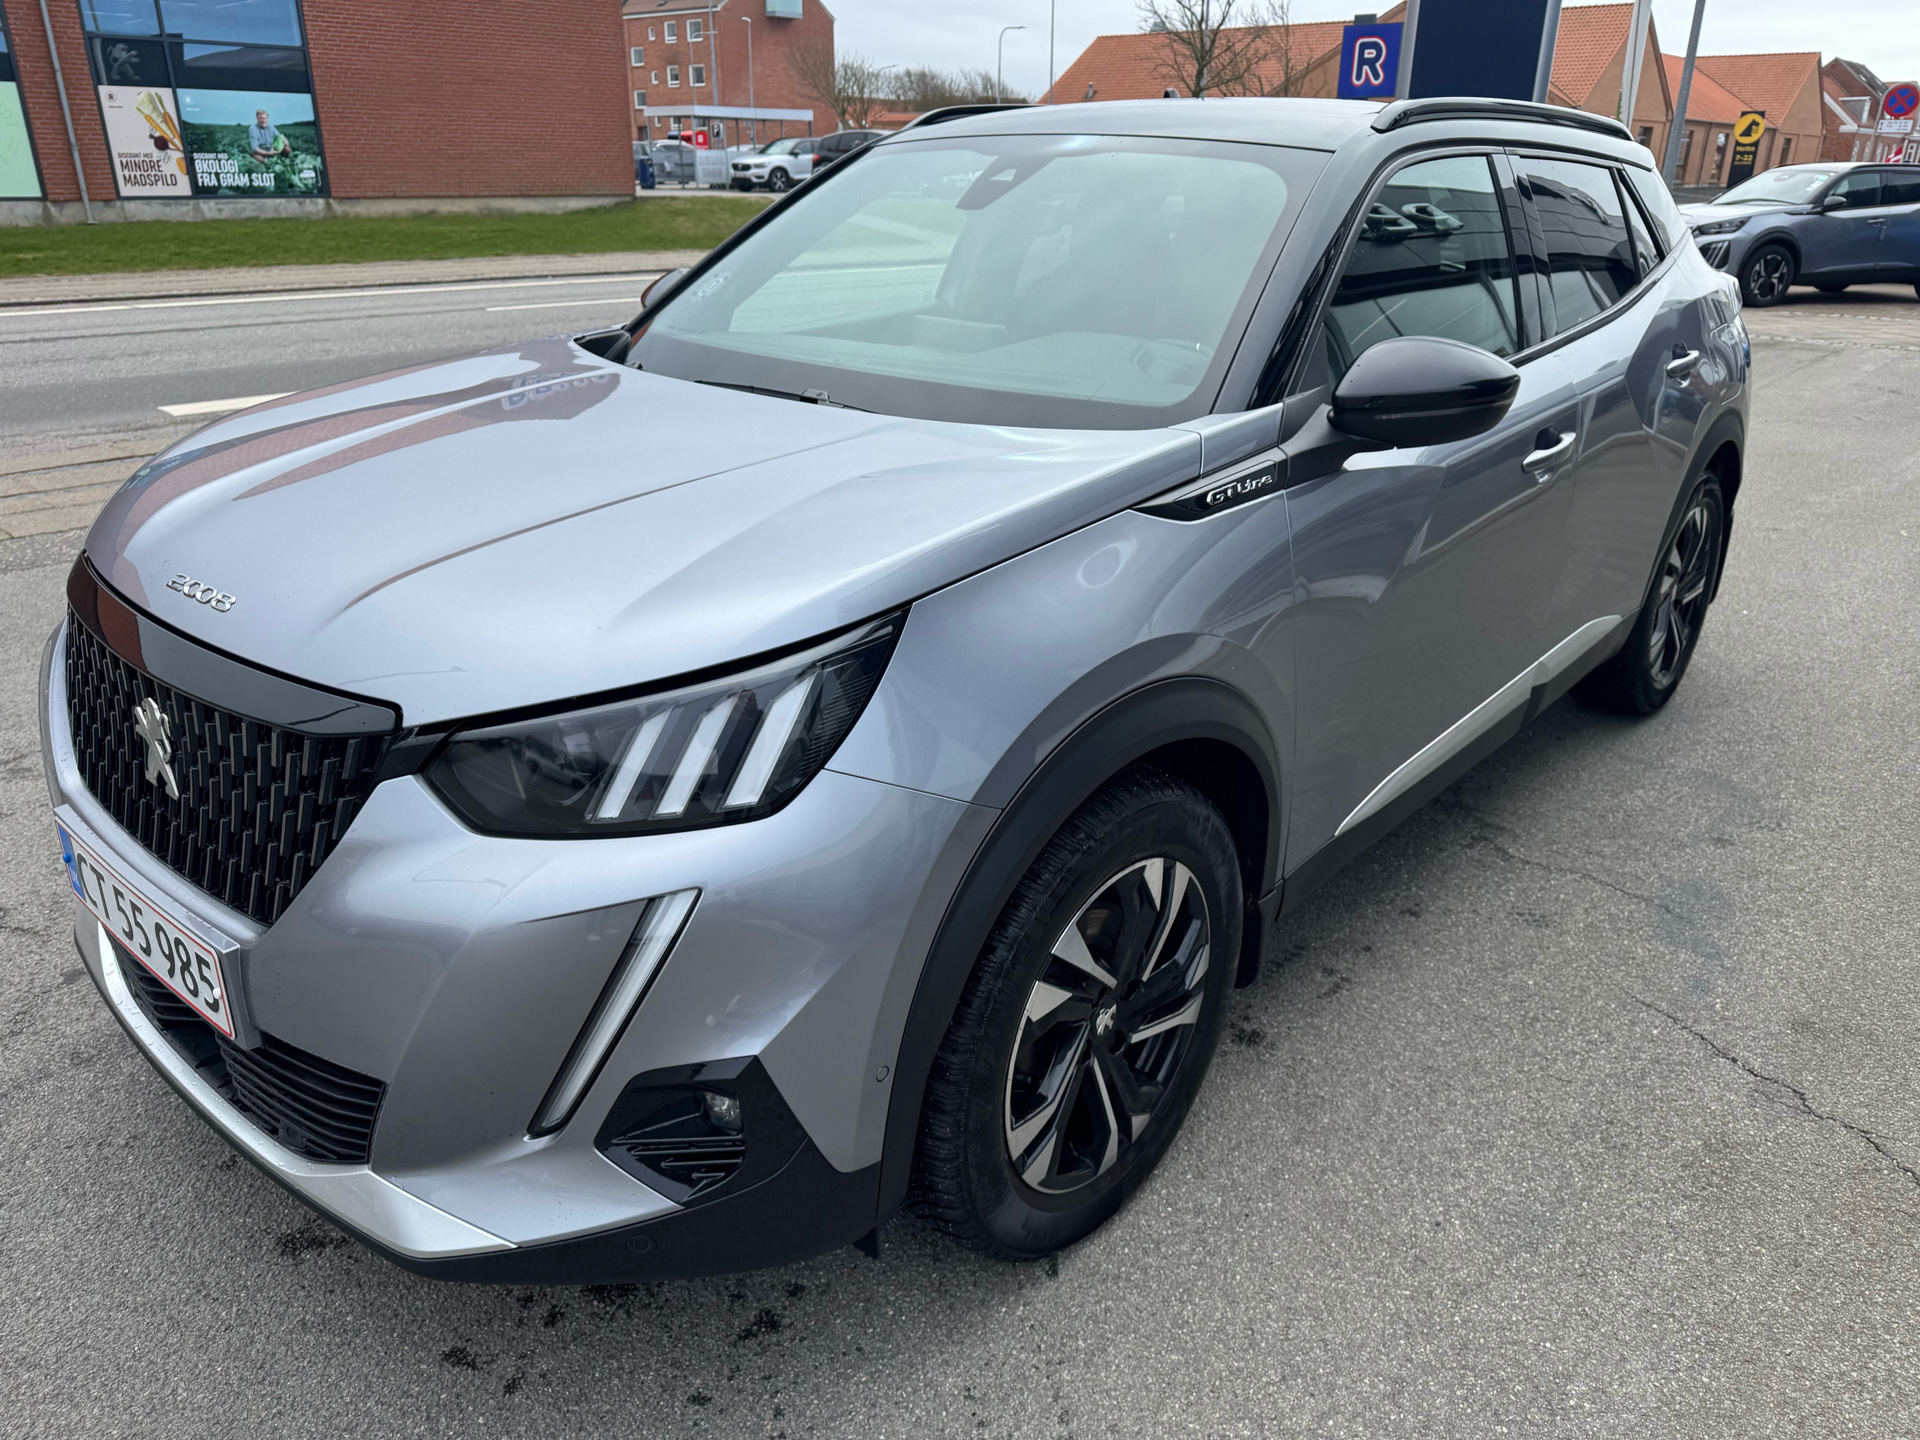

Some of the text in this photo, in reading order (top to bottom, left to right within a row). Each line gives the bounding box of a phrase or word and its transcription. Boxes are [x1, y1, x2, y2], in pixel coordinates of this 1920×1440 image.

[1351, 35, 1387, 87] R
[119, 159, 163, 173] MINDRE
[194, 160, 239, 173] ØKOLOGI
[122, 173, 178, 187] MADSPILD
[197, 172, 275, 187] FRA GRAM SLOT
[166, 572, 237, 613] 2008
[77, 852, 219, 1013] CT 55 985
